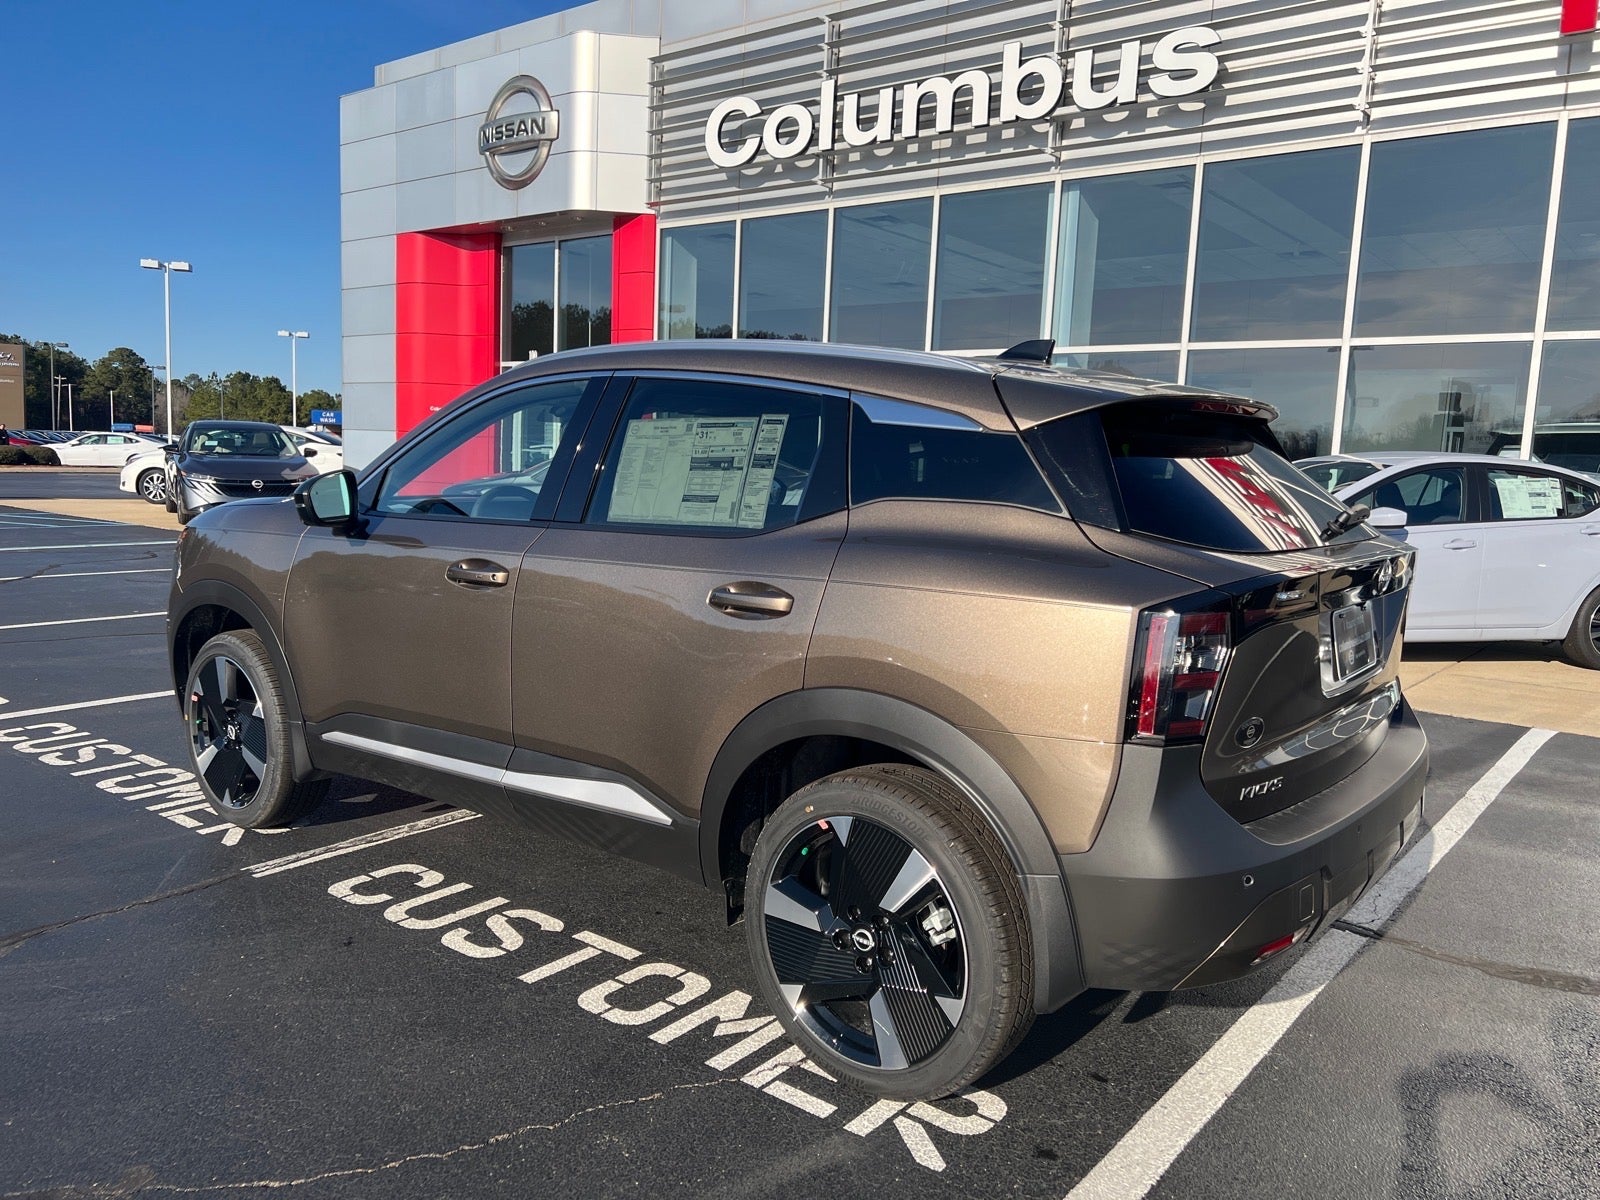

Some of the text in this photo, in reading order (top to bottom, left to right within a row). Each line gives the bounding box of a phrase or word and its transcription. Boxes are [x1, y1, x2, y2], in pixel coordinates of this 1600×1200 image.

[704, 27, 1222, 168] Columbus
[480, 116, 546, 147] NISSAN
[699, 430, 708, 440] 31
[1240, 776, 1283, 801] KICKS
[327, 863, 1008, 1172] CUSTOMER
